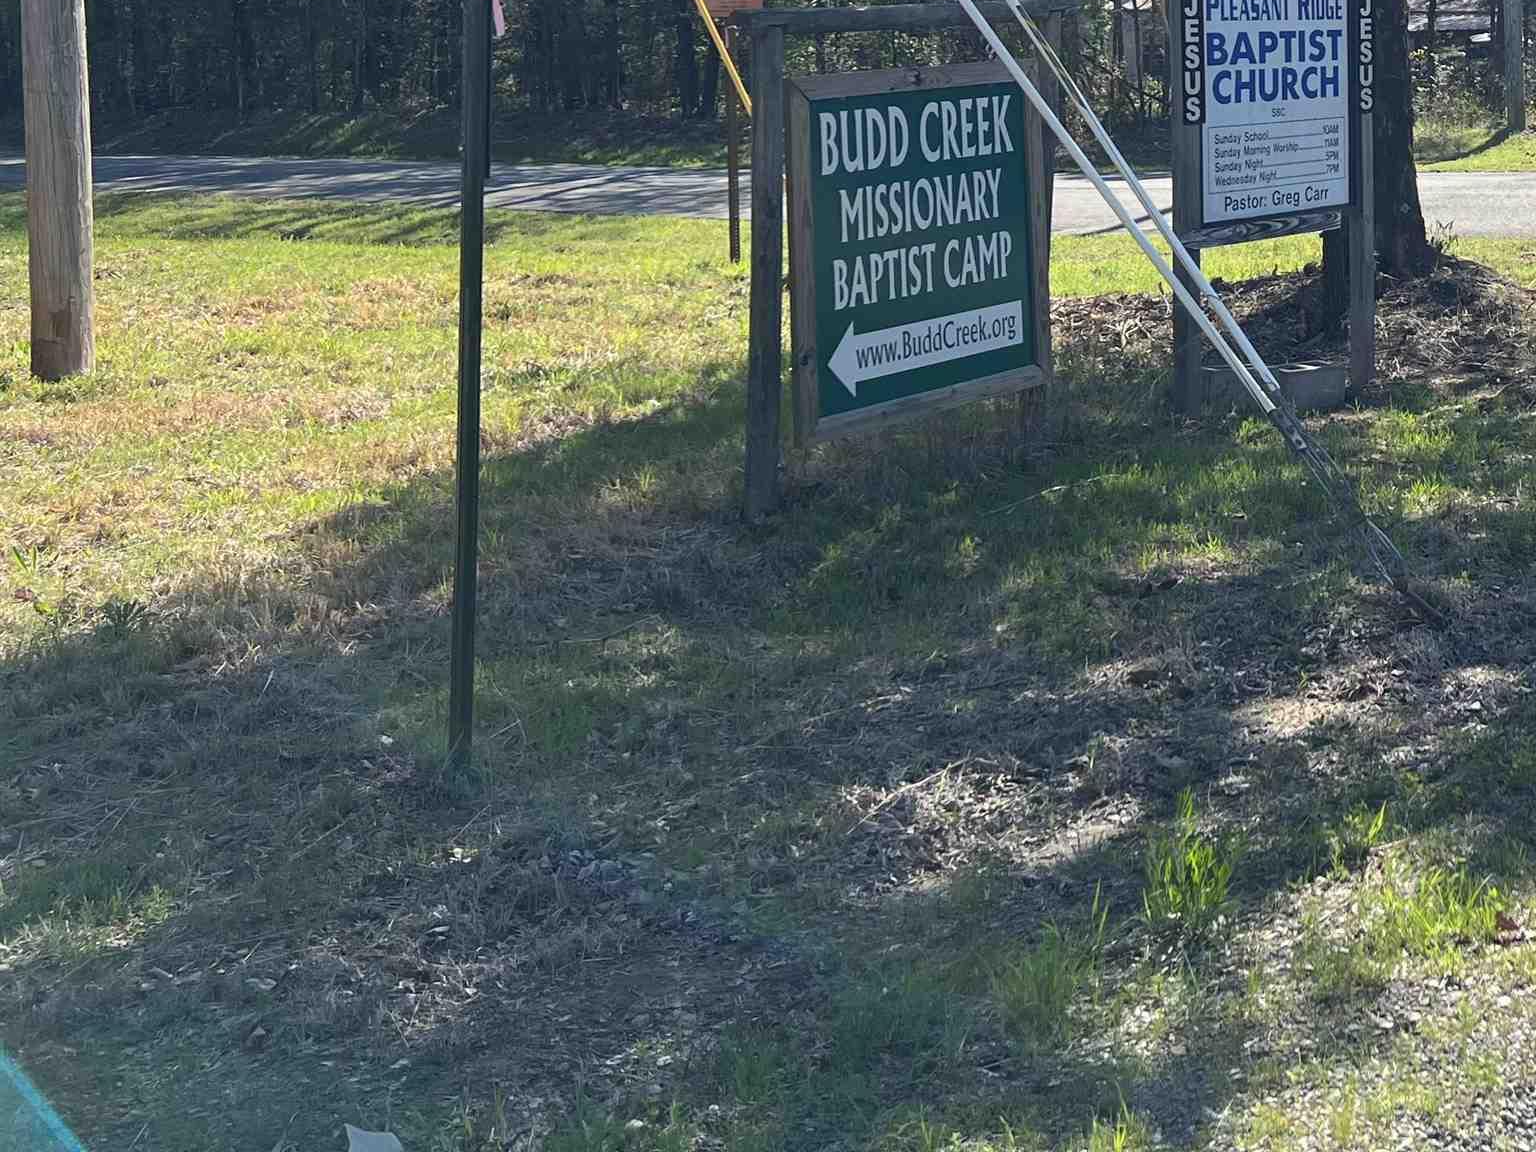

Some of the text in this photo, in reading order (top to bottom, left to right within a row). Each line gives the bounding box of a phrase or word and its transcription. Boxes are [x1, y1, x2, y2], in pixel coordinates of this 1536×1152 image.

[1206, 29, 1343, 66] BAPTIST
[1213, 66, 1340, 104] CHURCH
[819, 95, 1014, 176] BUDD CREEK
[1214, 134, 1241, 145] Sunday
[1244, 131, 1269, 142] School
[1214, 148, 1241, 159] Sunday
[1244, 145, 1271, 155] Morning
[1273, 142, 1299, 152] Worship
[1215, 162, 1242, 173] Sunday
[1245, 159, 1263, 171] Night
[1215, 174, 1257, 186] Wednesday
[1259, 170, 1277, 183] Night
[839, 168, 1001, 242] MISSIONARY
[1224, 186, 1329, 212] Pastor: Greg Carr
[833, 231, 1012, 310] BAPTIST CAMP
[856, 315, 1016, 369] www.BuddCreek.org
